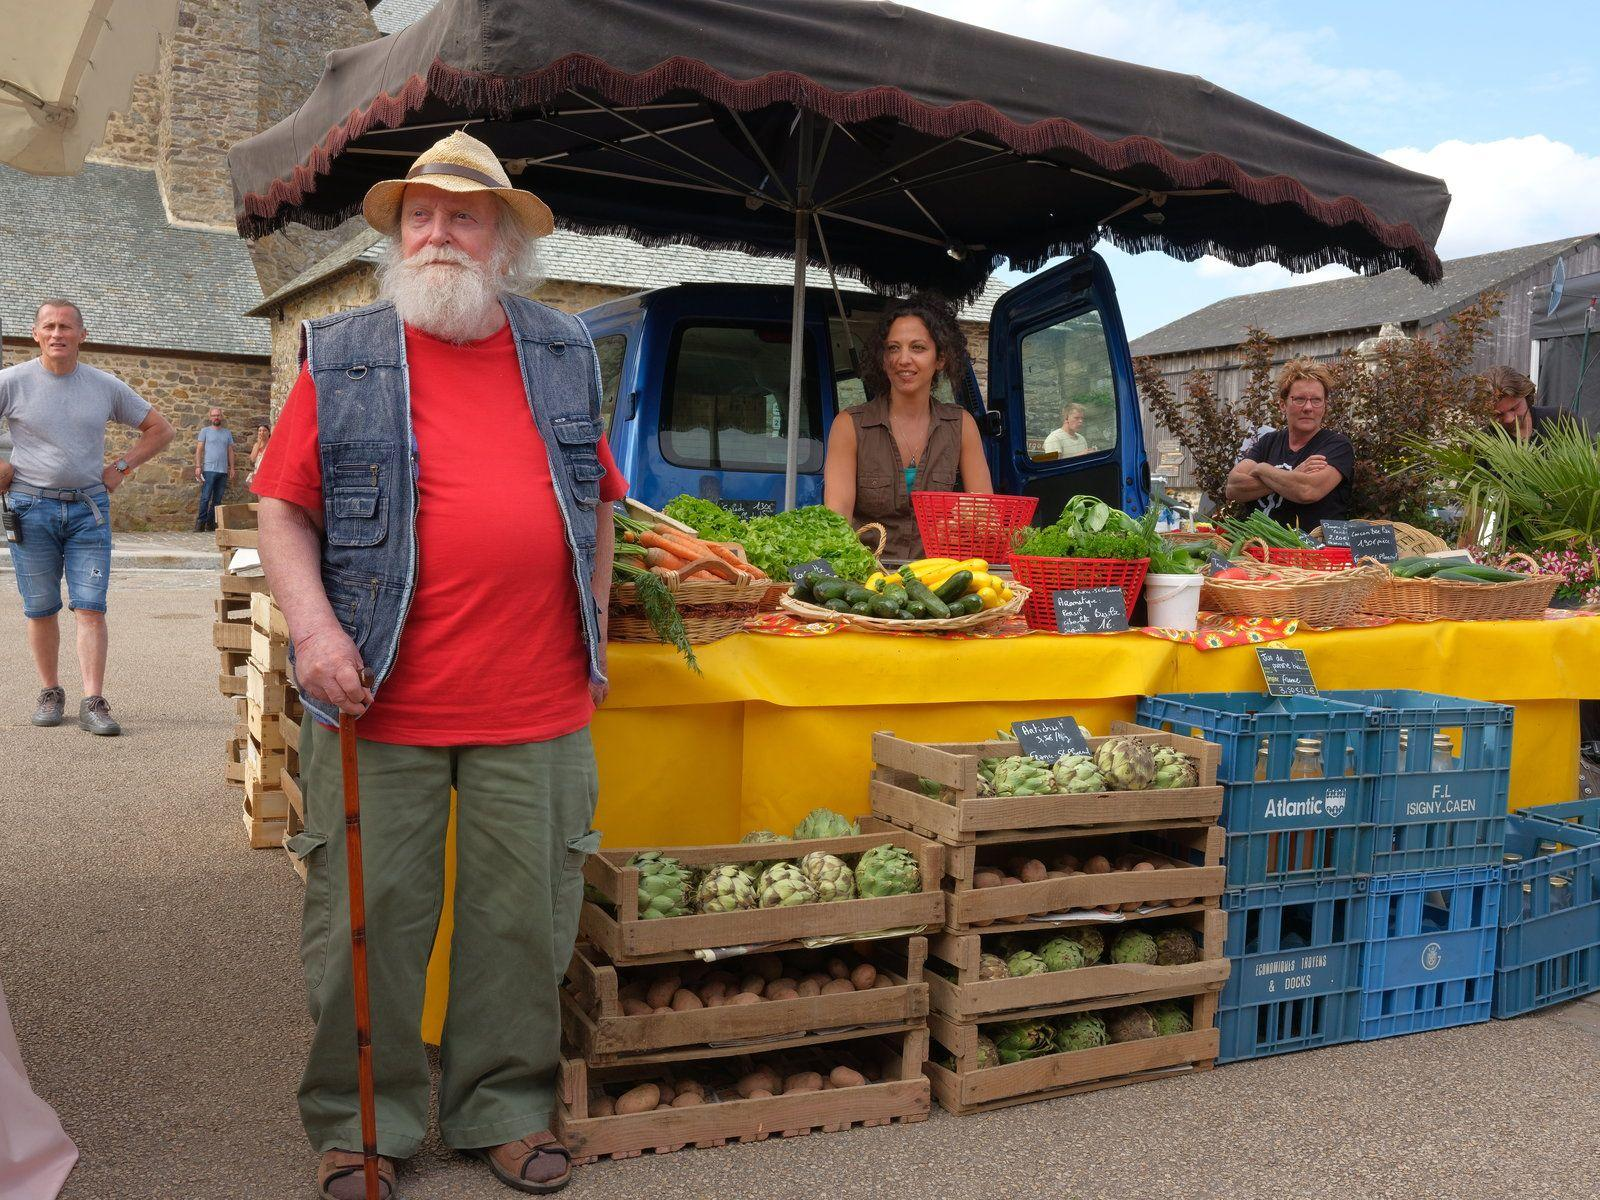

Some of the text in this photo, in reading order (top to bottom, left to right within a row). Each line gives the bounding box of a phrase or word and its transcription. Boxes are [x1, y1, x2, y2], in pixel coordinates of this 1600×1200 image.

[1264, 797, 1323, 818] Atlantic
[1268, 974, 1311, 992] & DOCKS
